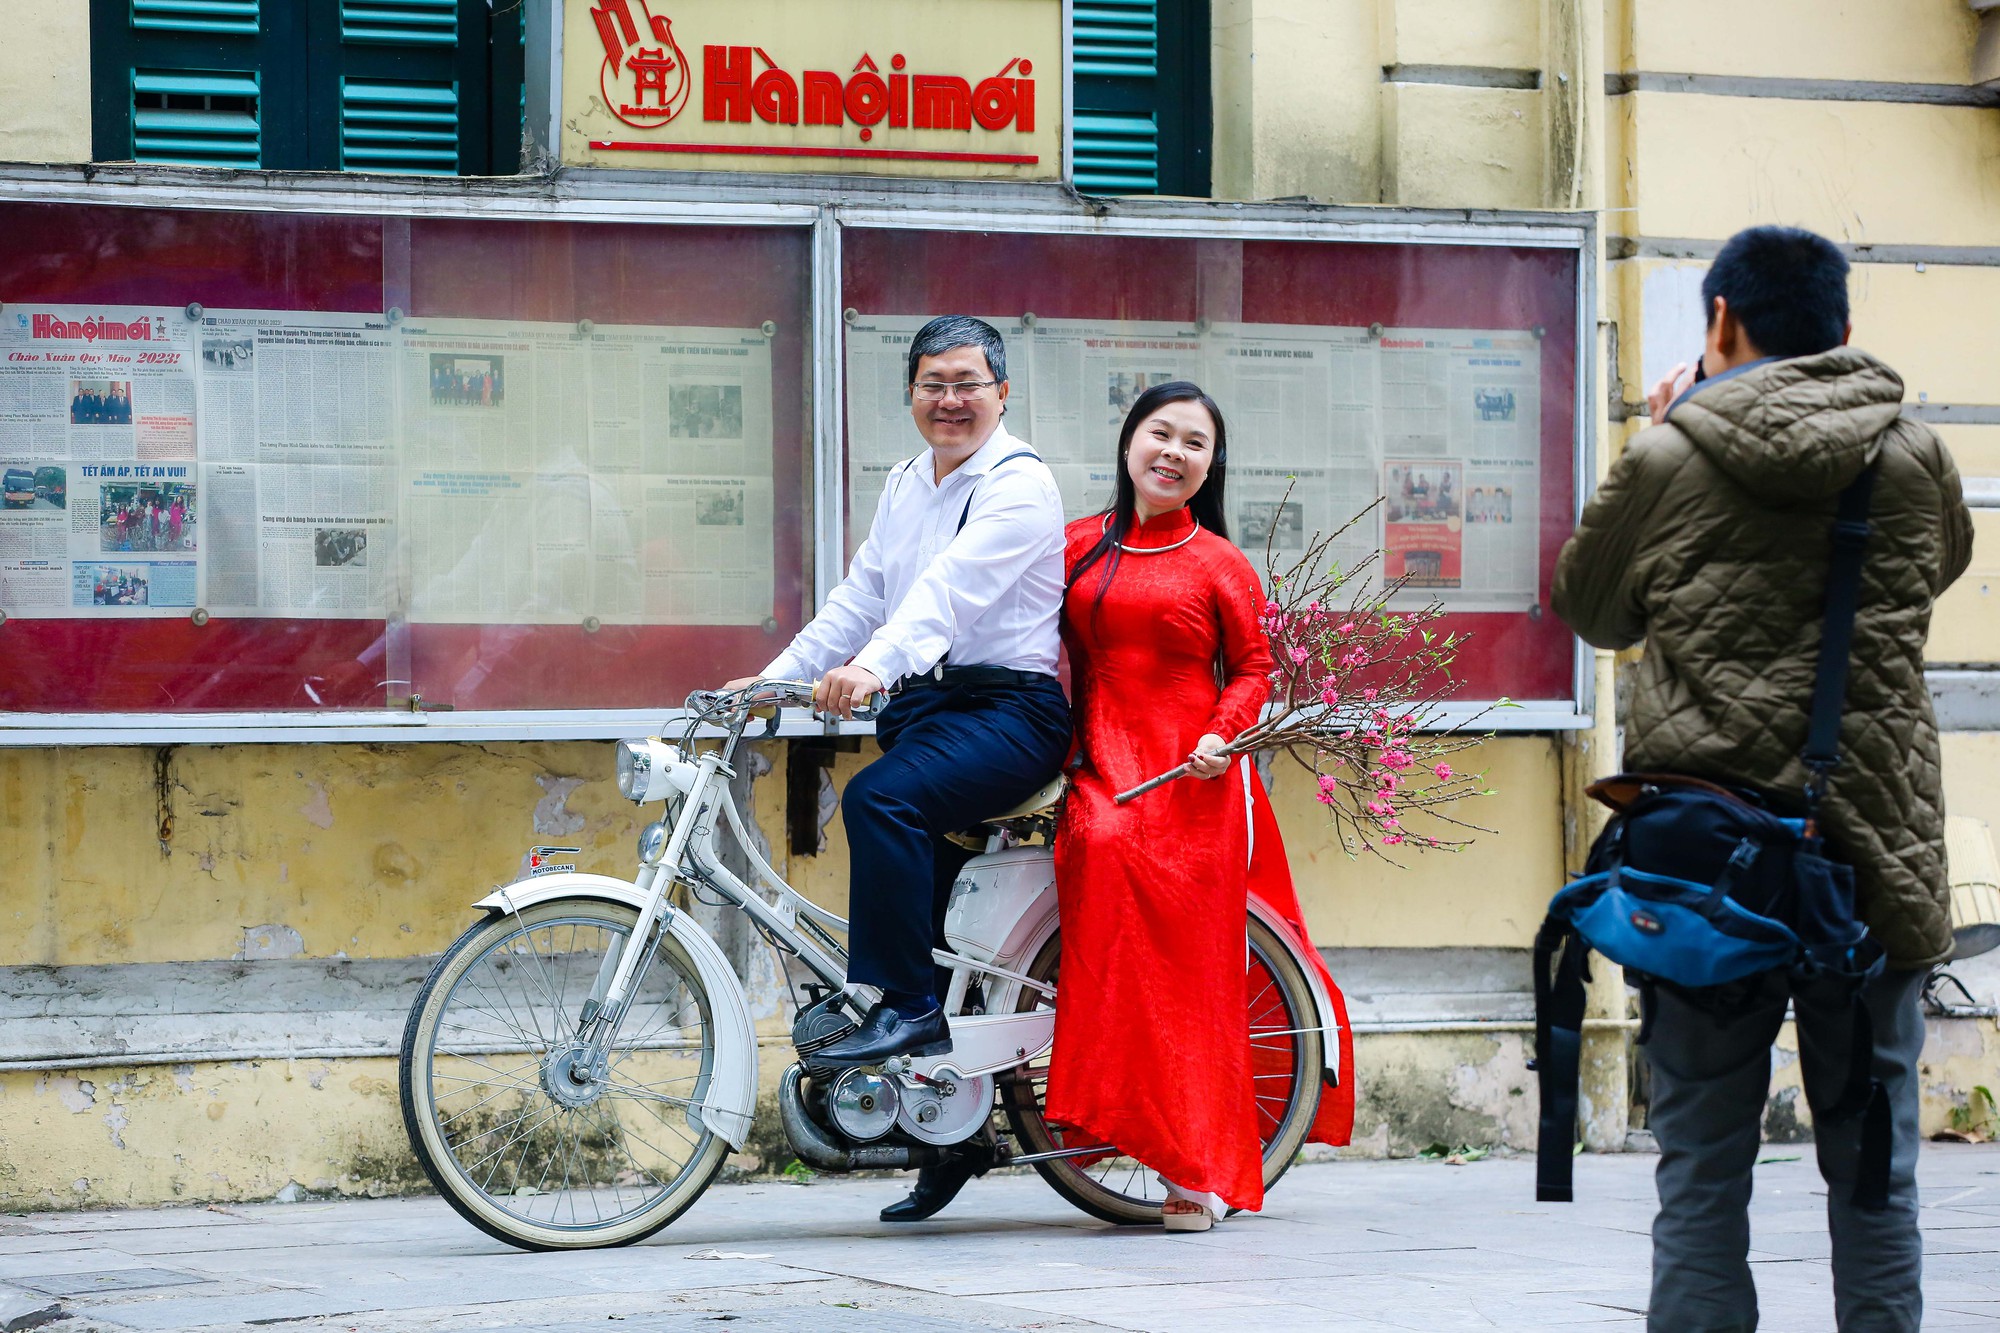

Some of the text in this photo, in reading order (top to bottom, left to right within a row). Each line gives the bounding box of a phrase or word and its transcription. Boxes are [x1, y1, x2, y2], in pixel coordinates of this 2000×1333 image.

[704, 44, 1035, 142] Hànộimới
[32, 313, 152, 343] Hànộimới
[8, 352, 181, 364] Chào Xuân Quý Mão 2023!
[82, 464, 186, 478] TẾT ẤM ÁP, TẾT AN VUI!
[532, 864, 574, 875] MOTOBECANE
[453, 927, 502, 973] MOBYLETTE
